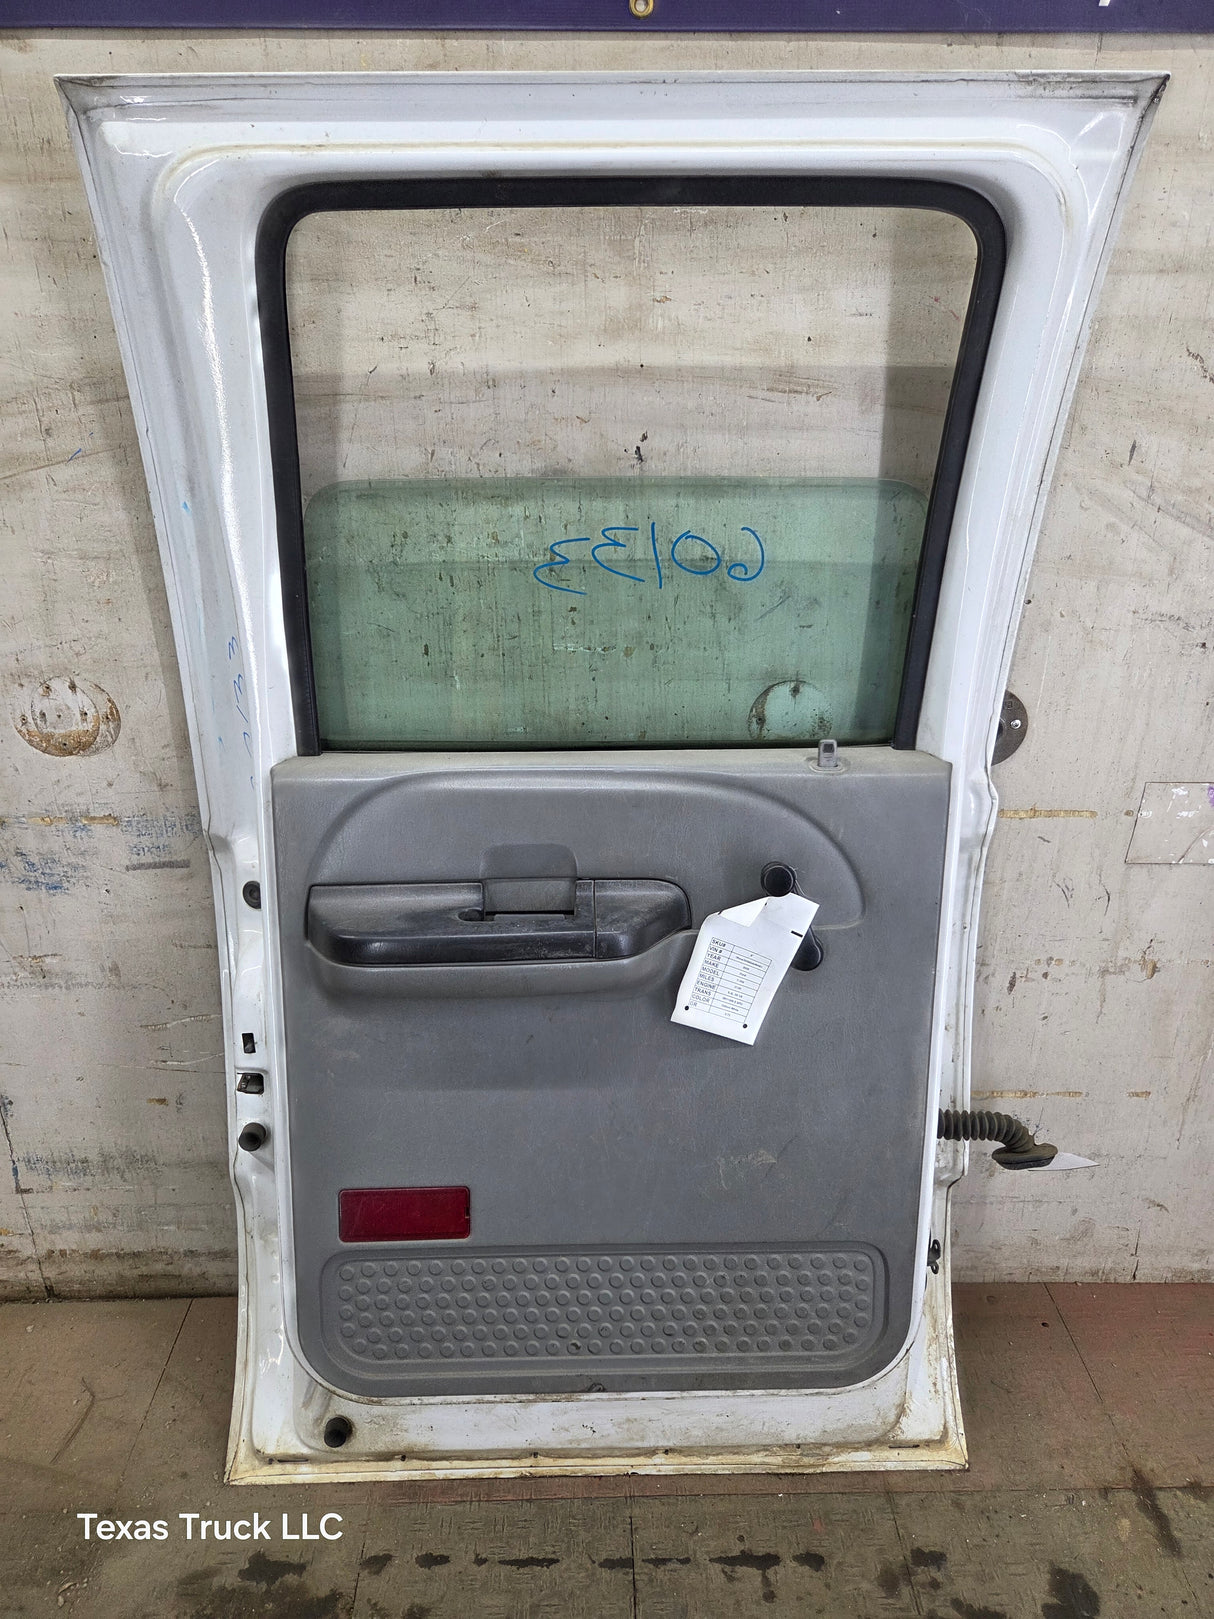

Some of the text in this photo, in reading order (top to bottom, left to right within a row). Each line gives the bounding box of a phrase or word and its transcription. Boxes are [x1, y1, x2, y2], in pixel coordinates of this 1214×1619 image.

[711, 939, 726, 948] SKU#
[707, 953, 721, 961] YEAR
[704, 959, 719, 968] MAKE
[702, 966, 719, 976] MODEL
[699, 973, 715, 982] MILES
[697, 980, 716, 990] ENGINE
[694, 987, 711, 996] TRANS
[692, 994, 710, 1003] COLOR
